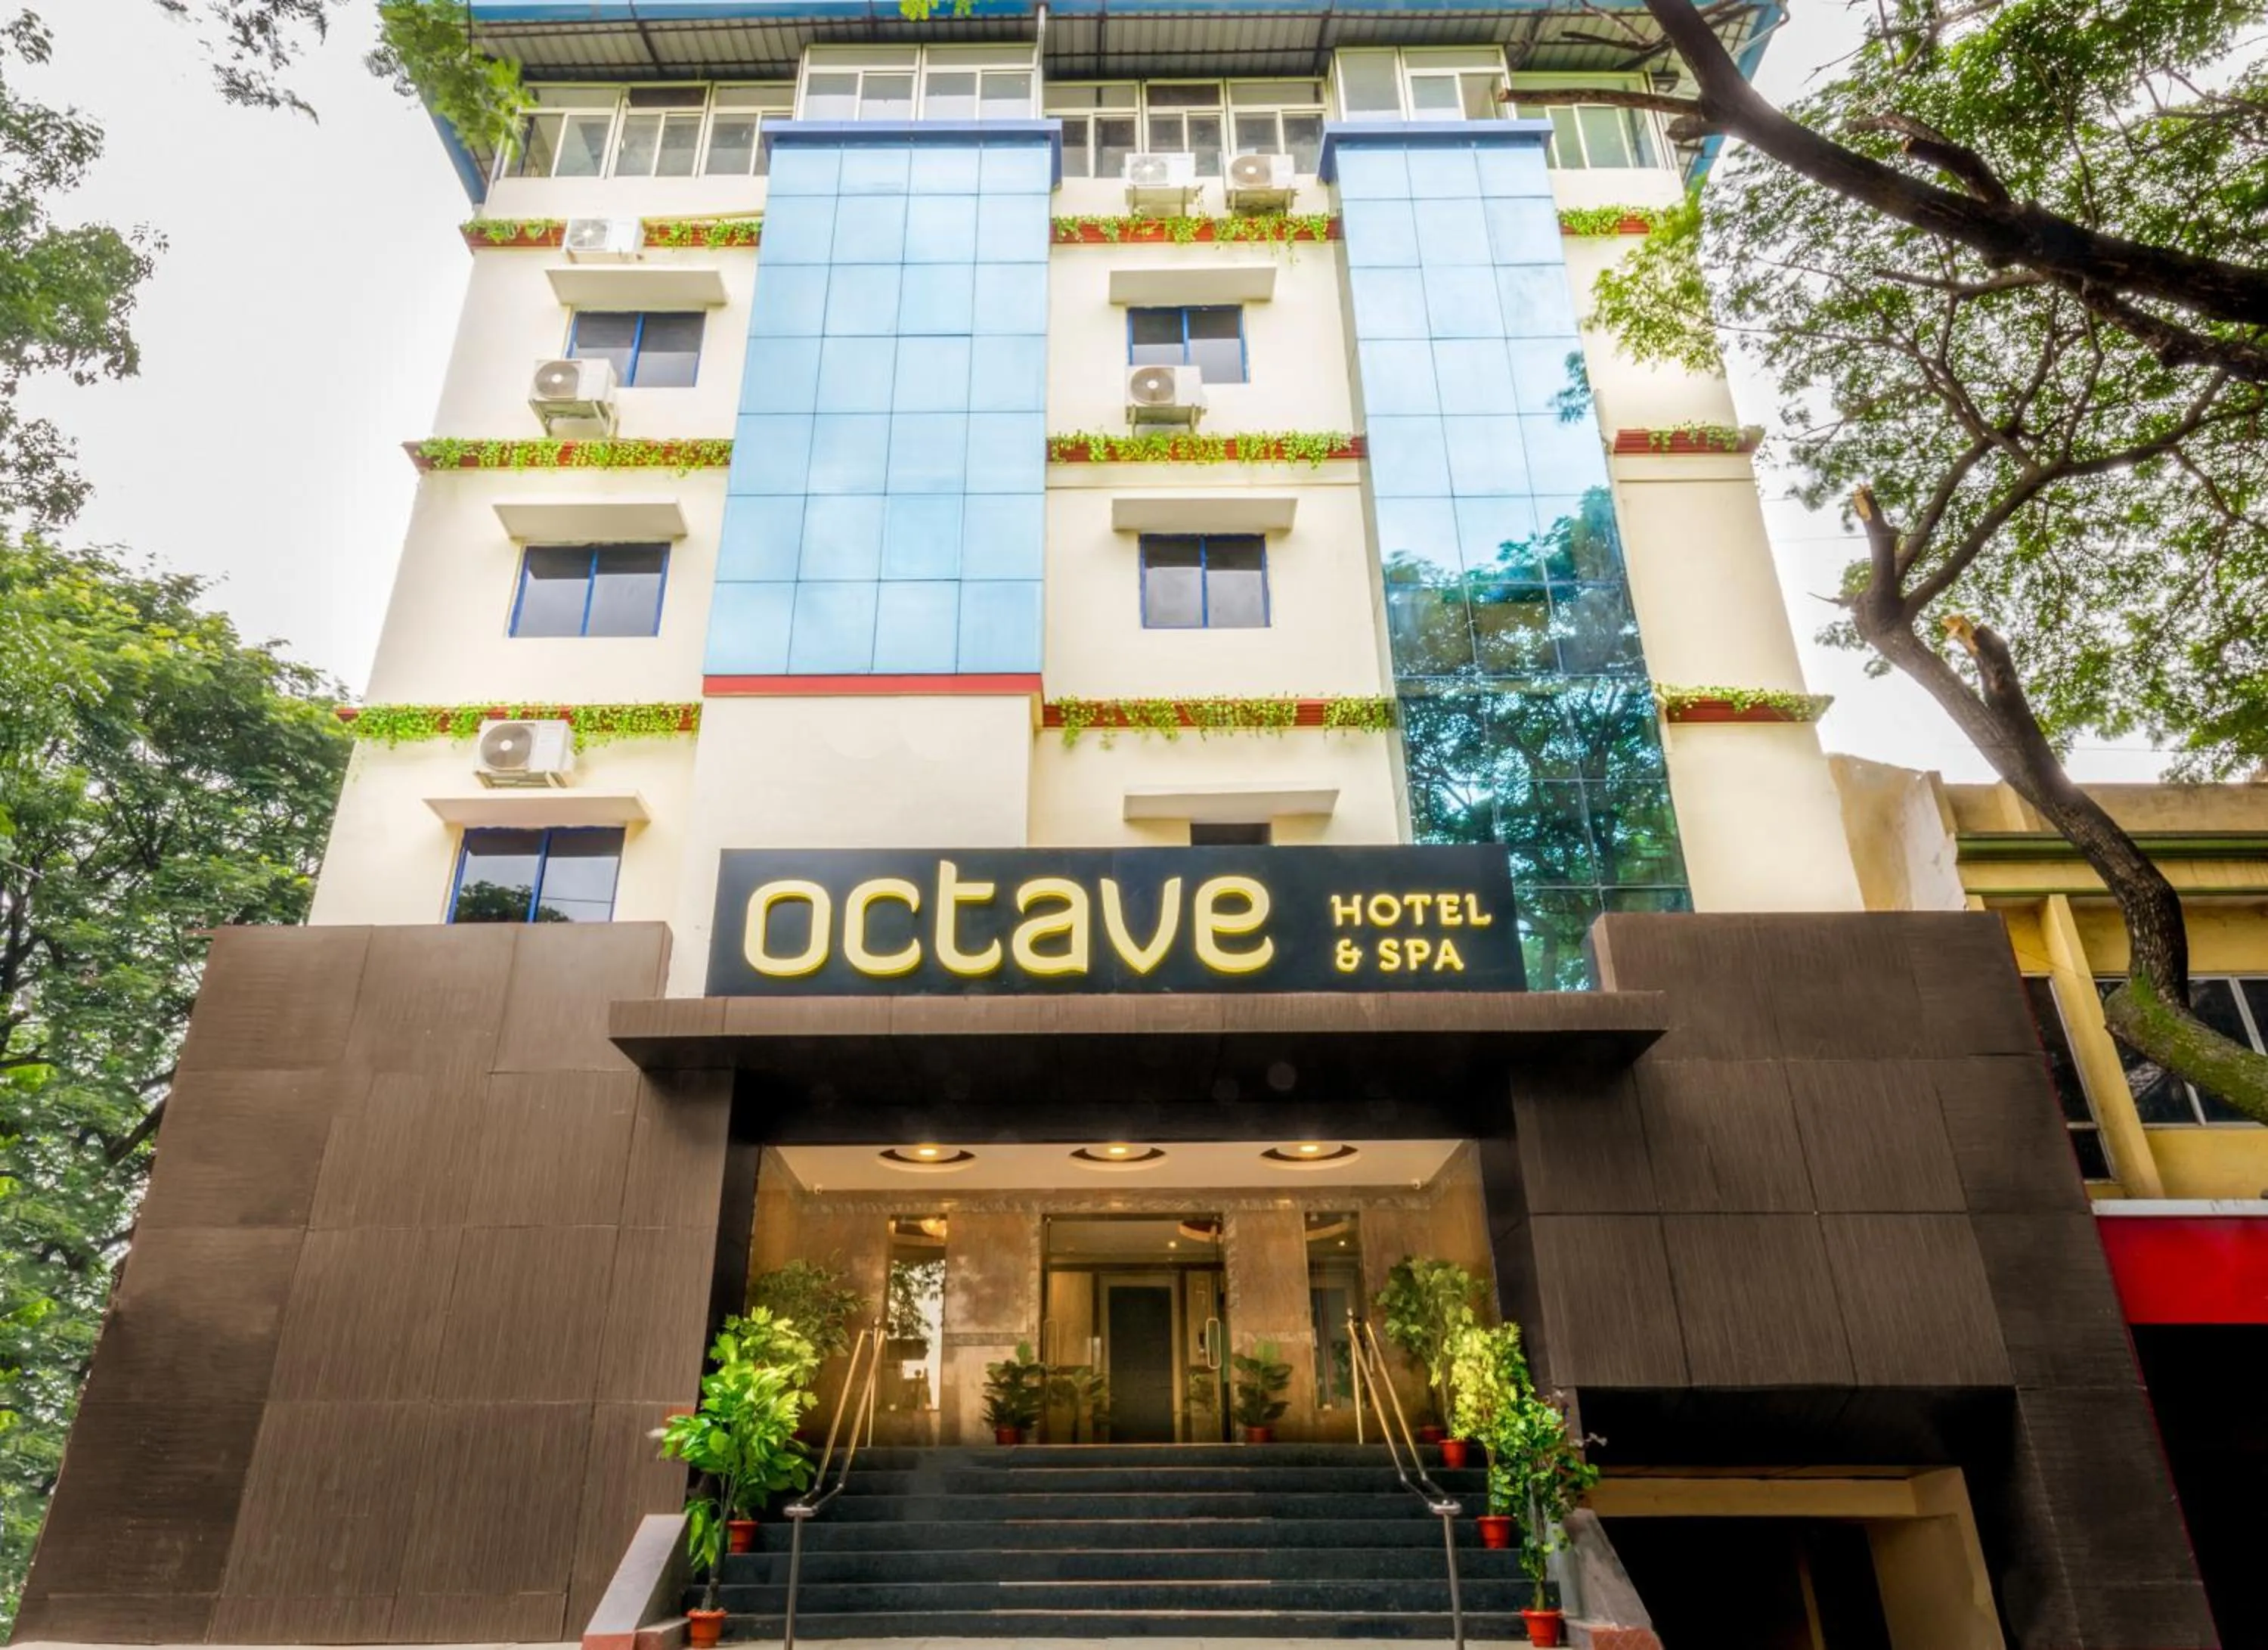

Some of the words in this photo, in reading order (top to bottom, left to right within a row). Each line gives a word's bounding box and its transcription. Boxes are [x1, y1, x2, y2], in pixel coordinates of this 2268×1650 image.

[743, 860, 1274, 976] octave
[1331, 892, 1492, 927] HOTEL
[1334, 938, 1362, 972] &
[1377, 938, 1464, 972] SPA
